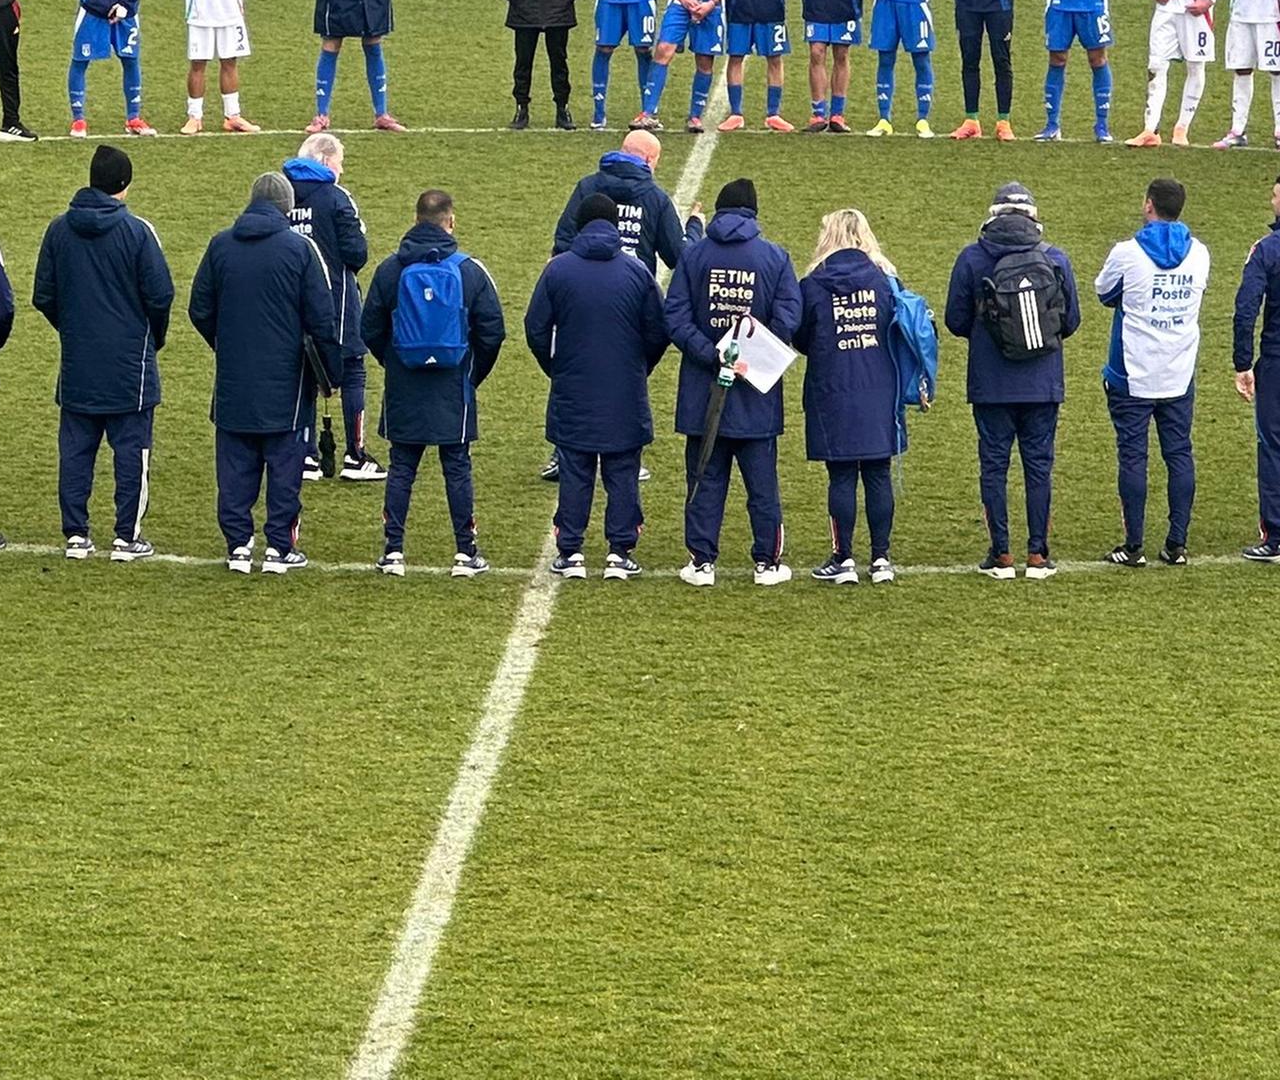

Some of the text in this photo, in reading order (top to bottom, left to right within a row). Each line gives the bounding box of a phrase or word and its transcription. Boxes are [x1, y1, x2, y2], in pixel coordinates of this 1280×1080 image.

[643, 15, 655, 33] 10
[920, 21, 928, 39] 11
[1096, 15, 1110, 34] 15
[128, 27, 137, 45] 2
[236, 26, 244, 42] 3
[1198, 31, 1207, 48] 8
[290, 207, 312, 221] TIM
[617, 204, 642, 220] TIM
[618, 220, 641, 232] ste
[727, 269, 755, 285] TIM
[1169, 274, 1193, 286] TIM
[709, 284, 754, 300] Poste
[1152, 287, 1191, 300] Poste
[833, 305, 877, 320] Poste
[710, 315, 730, 328] eni
[837, 335, 860, 350] eni
